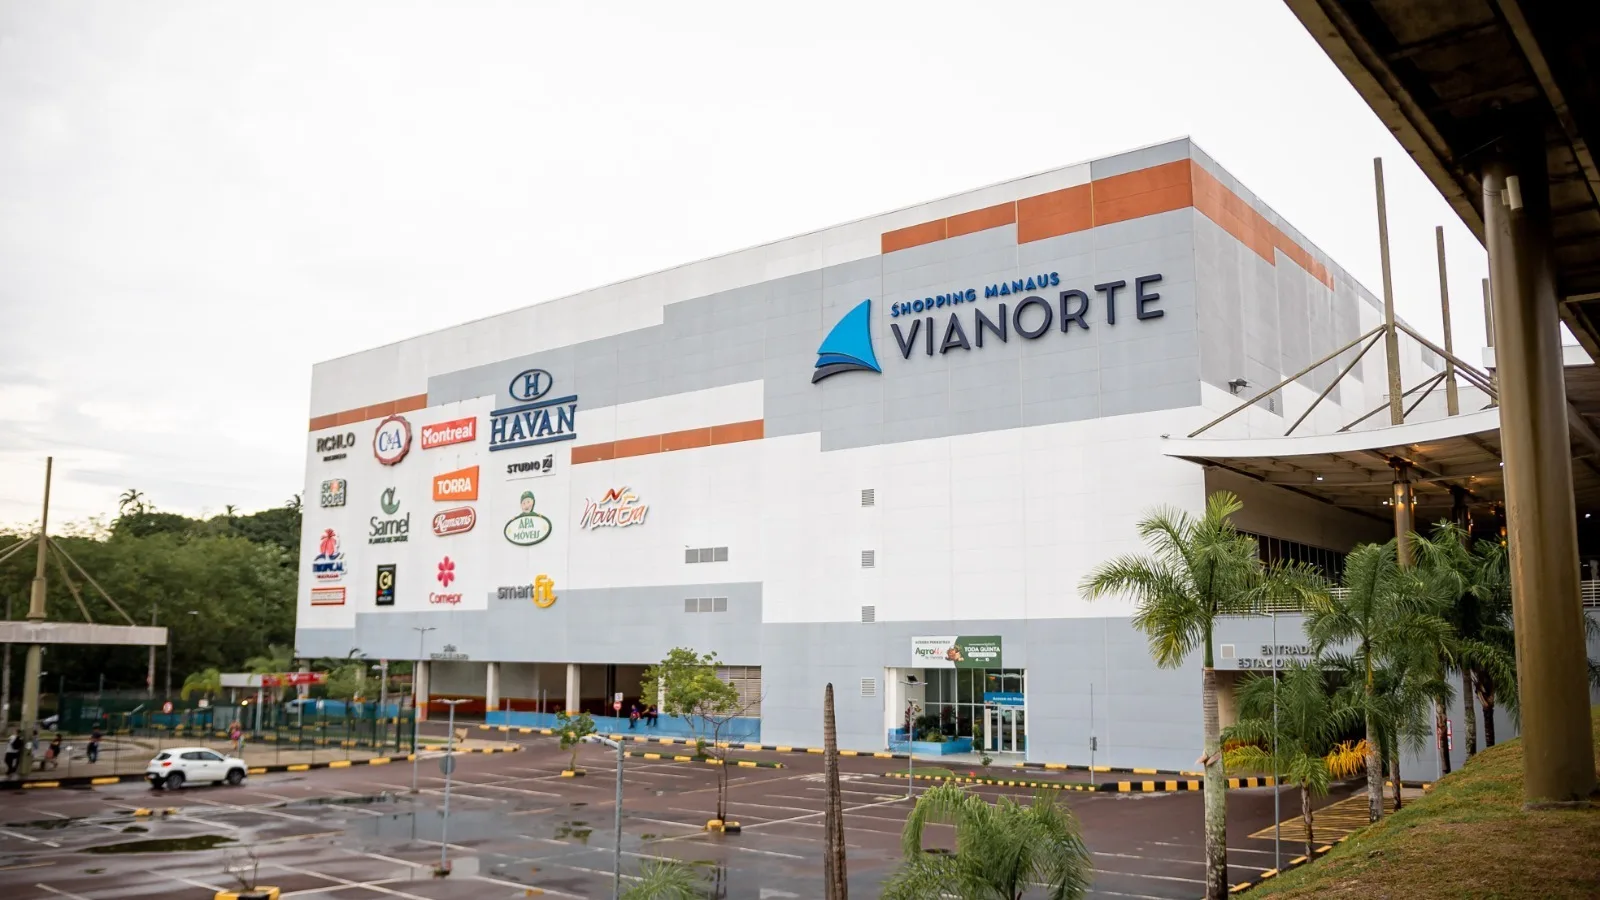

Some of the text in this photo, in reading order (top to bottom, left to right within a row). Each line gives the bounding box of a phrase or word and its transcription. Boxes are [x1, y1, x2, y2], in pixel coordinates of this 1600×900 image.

[891, 271, 1060, 317] SHOPPING MANAUS
[890, 273, 1164, 359] VIANORTE
[523, 372, 541, 397] H
[423, 421, 473, 446] Montreal
[489, 404, 577, 445] HAVAN
[316, 432, 355, 452] RCHLO
[379, 428, 402, 452] C&A
[507, 461, 540, 474] STUDIO
[437, 477, 472, 494] TORRA
[369, 512, 410, 537] Samel
[518, 517, 534, 529] APA
[1261, 645, 1316, 655] ENTRADA
